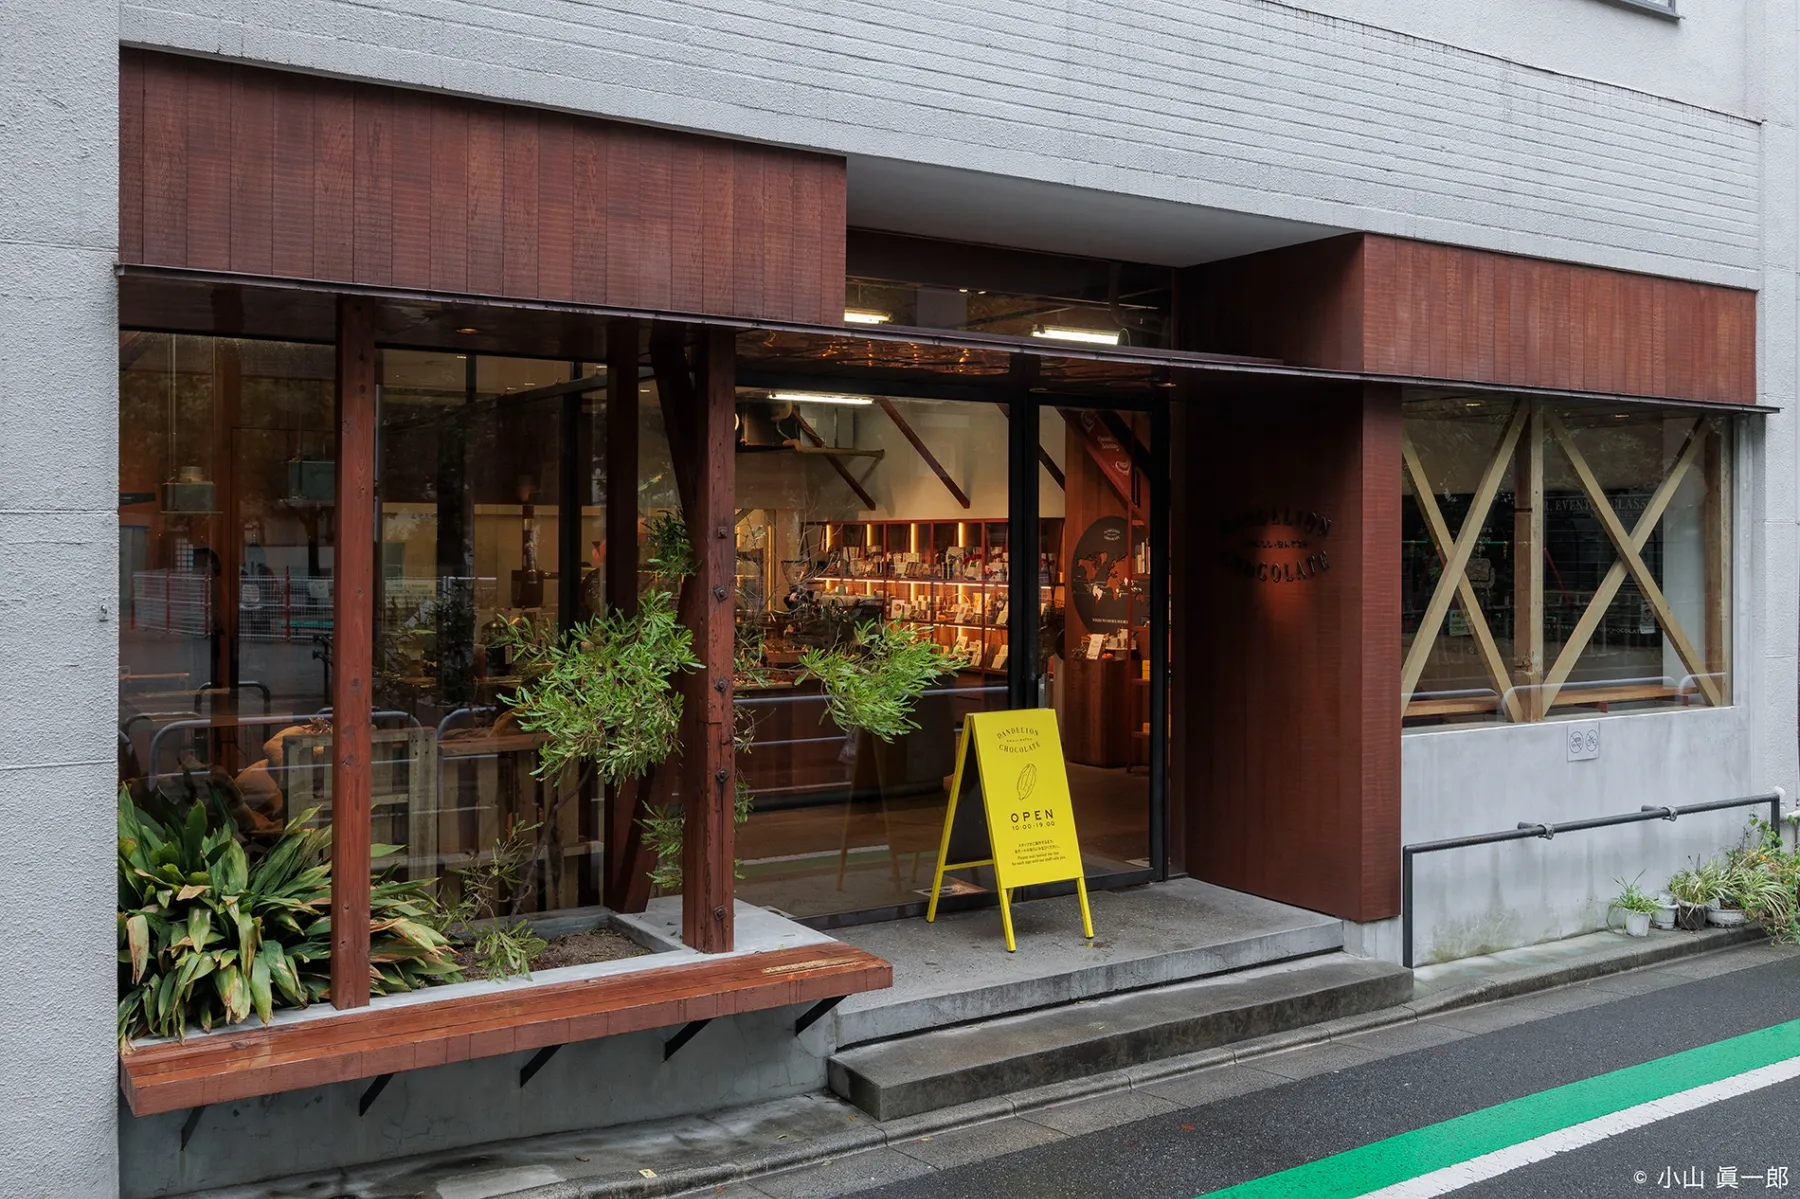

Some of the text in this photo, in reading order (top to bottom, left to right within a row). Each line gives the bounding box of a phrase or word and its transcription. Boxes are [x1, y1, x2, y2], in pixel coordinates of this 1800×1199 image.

[1611, 498, 1647, 509] CLASS
[1219, 506, 1332, 537] DELION
[1220, 550, 1331, 583] OCOLATE
[996, 726, 1039, 740] DANDELION
[998, 741, 1041, 754] CHOCOLATE
[1010, 808, 1054, 823] OPEN
